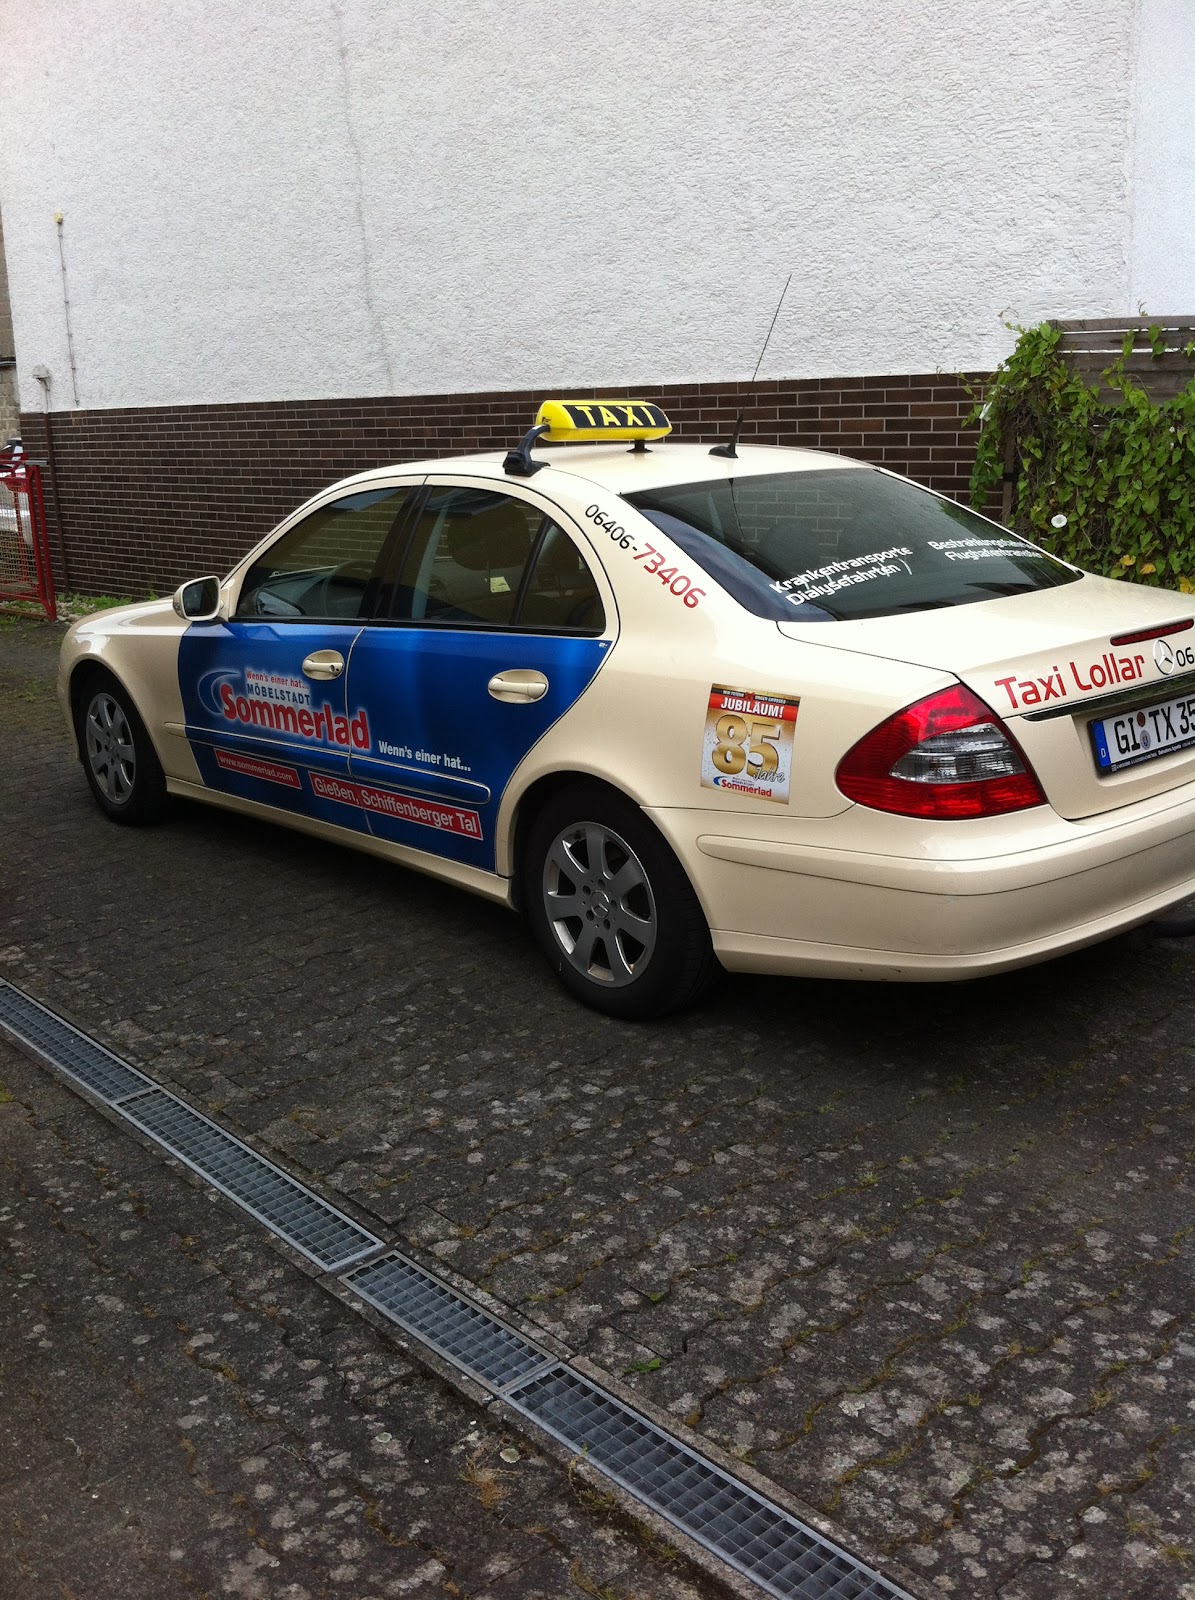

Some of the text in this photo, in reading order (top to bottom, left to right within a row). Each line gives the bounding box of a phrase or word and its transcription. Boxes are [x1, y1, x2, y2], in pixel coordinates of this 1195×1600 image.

[574, 406, 656, 426] TAXI
[769, 545, 914, 594] Krankentransporte
[785, 563, 902, 607] Dialysefahrten
[245, 669, 269, 682] Wenn's
[270, 677, 288, 686] einer
[994, 652, 1145, 709] Taxi Lollar
[246, 683, 311, 706] MÖBELSTADT
[720, 697, 785, 718] JUBILÄUM!
[219, 683, 371, 750] Sommerlad
[1113, 717, 1140, 754] GI
[1149, 707, 1177, 743] TX
[378, 740, 472, 772] Wenn's einer hat...
[711, 714, 781, 777] 85
[1100, 748, 1107, 758] D
[218, 756, 294, 782] www.sommerlad.com
[721, 779, 773, 798] Sommerlad
[314, 779, 478, 833] Gießen, Schiffenberger Tal
